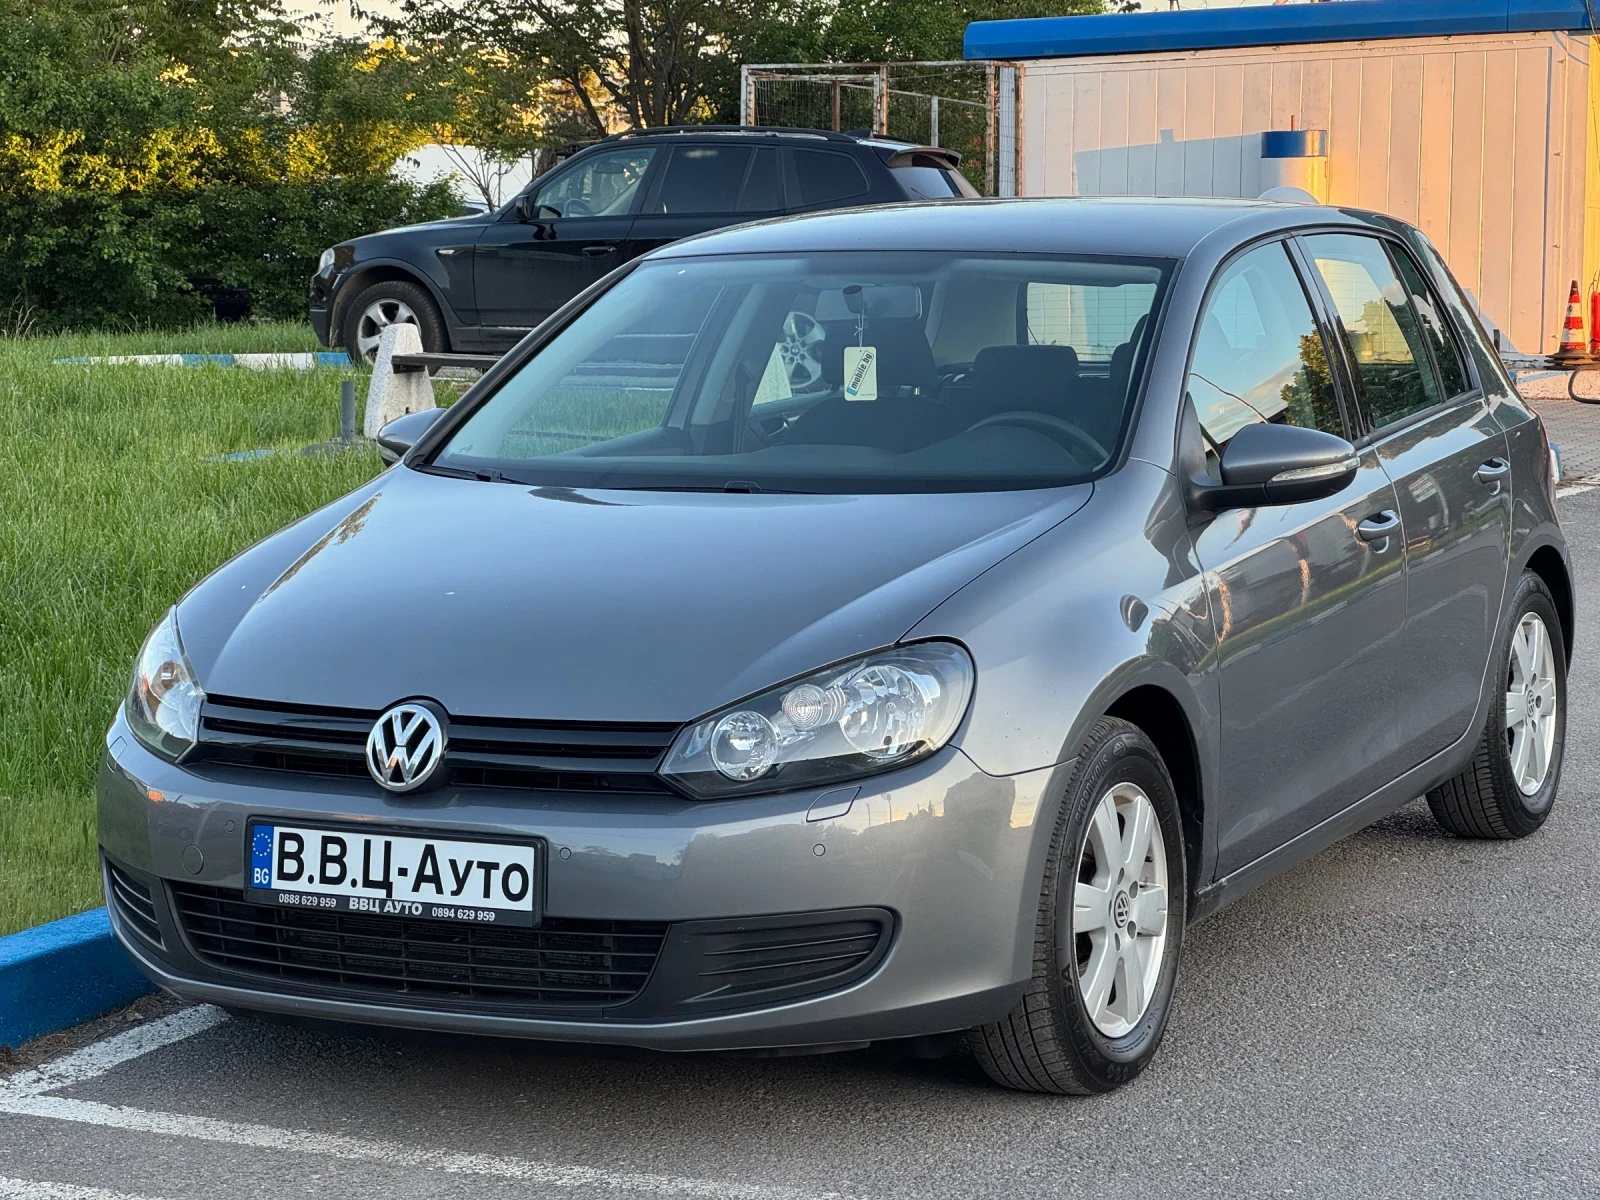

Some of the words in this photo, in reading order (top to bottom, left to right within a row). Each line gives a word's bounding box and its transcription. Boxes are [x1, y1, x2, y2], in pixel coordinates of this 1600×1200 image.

[851, 353, 873, 390] mobile.bg
[371, 709, 437, 785] VW
[276, 831, 530, 902] В.В.Ц-Ауто
[253, 867, 269, 885] BG
[278, 893, 300, 905] 0888
[301, 895, 318, 906] 629
[319, 897, 337, 908] 959
[349, 897, 380, 913] ВВЦ
[383, 900, 423, 915] АУТО
[431, 907, 455, 918] 0894
[457, 909, 475, 920] 629
[477, 911, 496, 921] 959
